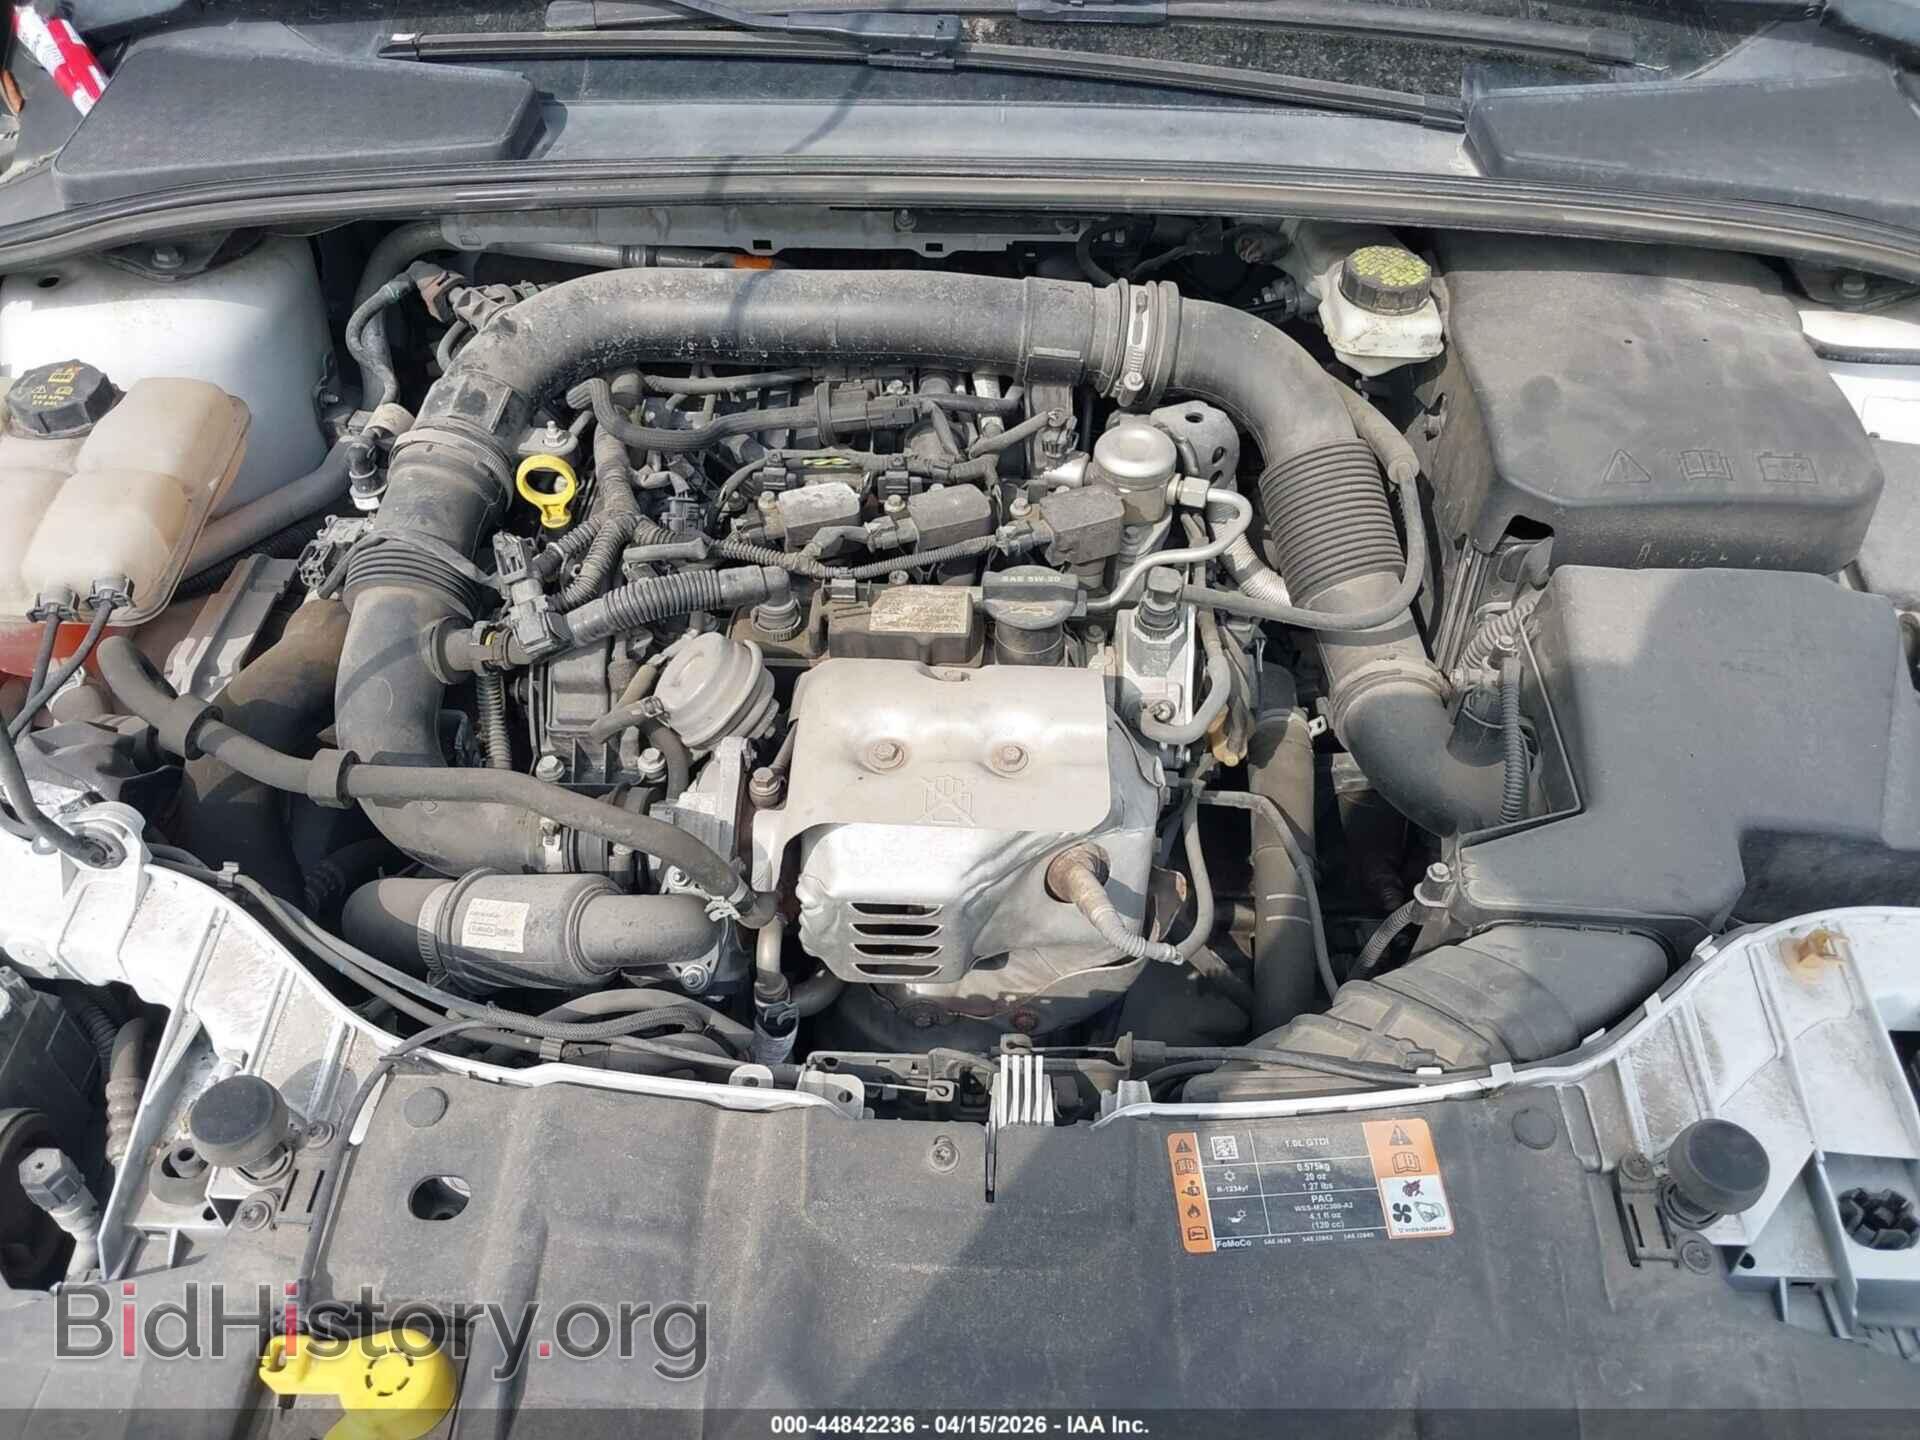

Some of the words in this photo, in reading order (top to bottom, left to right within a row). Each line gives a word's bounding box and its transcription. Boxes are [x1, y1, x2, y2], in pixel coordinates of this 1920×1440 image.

[1296, 1162, 1331, 1172] 0.575kg
[1304, 1173, 1314, 1181] 20
[1216, 1184, 1249, 1193] R-1234yf
[1302, 1182, 1318, 1191] 1.27
[1311, 1194, 1333, 1203] PAG
[1310, 1212, 1321, 1220] 4.1
[1311, 1221, 1330, 1230] (120
[1331, 1220, 1345, 1230] cc)
[1343, 1232, 1355, 1240] SAE
[1216, 1239, 1252, 1248] FoMoCo
